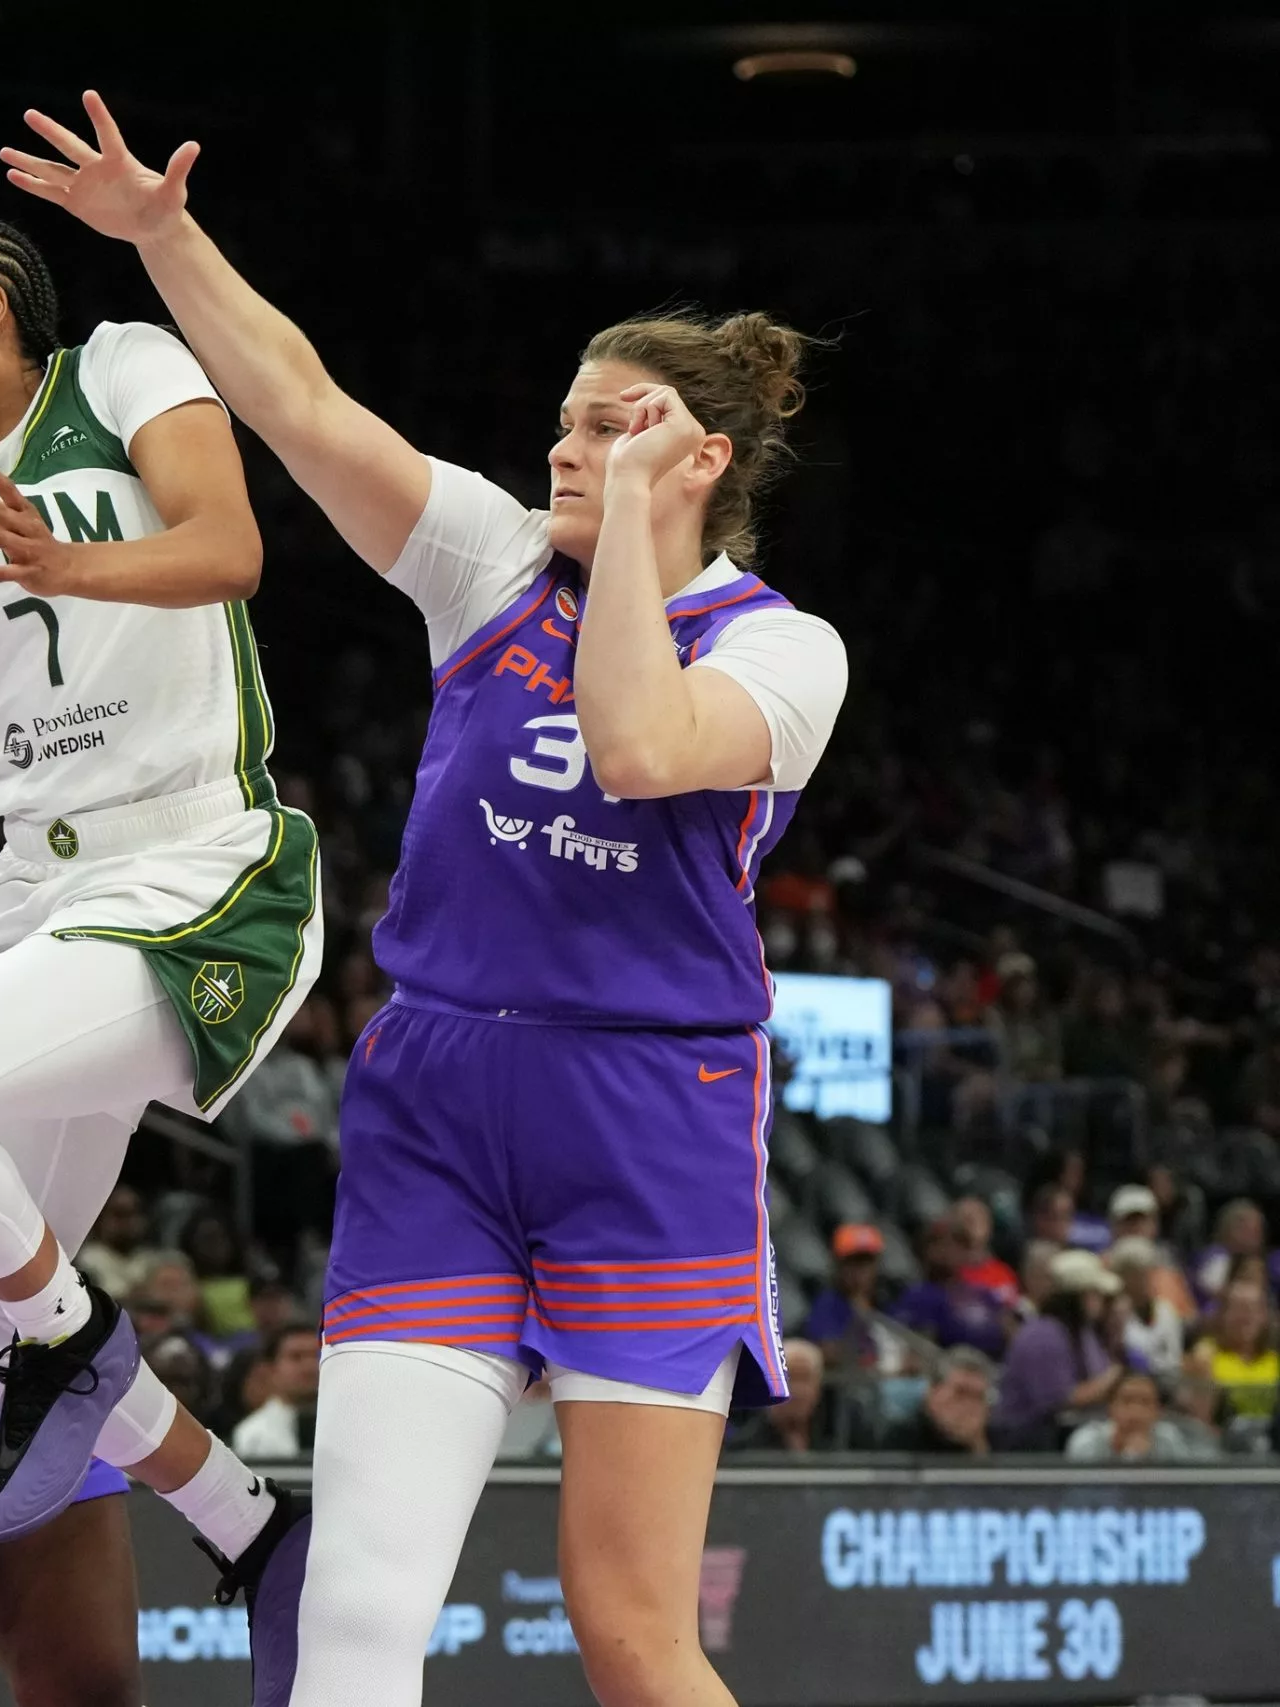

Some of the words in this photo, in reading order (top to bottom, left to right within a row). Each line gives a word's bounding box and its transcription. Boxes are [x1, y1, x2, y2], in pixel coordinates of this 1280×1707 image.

[41, 433, 87, 461] SYMETRA
[3, 597, 64, 687] 7
[509, 715, 621, 803] 3
[569, 832, 594, 845] FOOD
[595, 839, 630, 850] STORES
[822, 1508, 1206, 1588] CHAMPIONSHIP
[916, 1602, 1051, 1684] JUNE
[1057, 1599, 1123, 1681] 30
